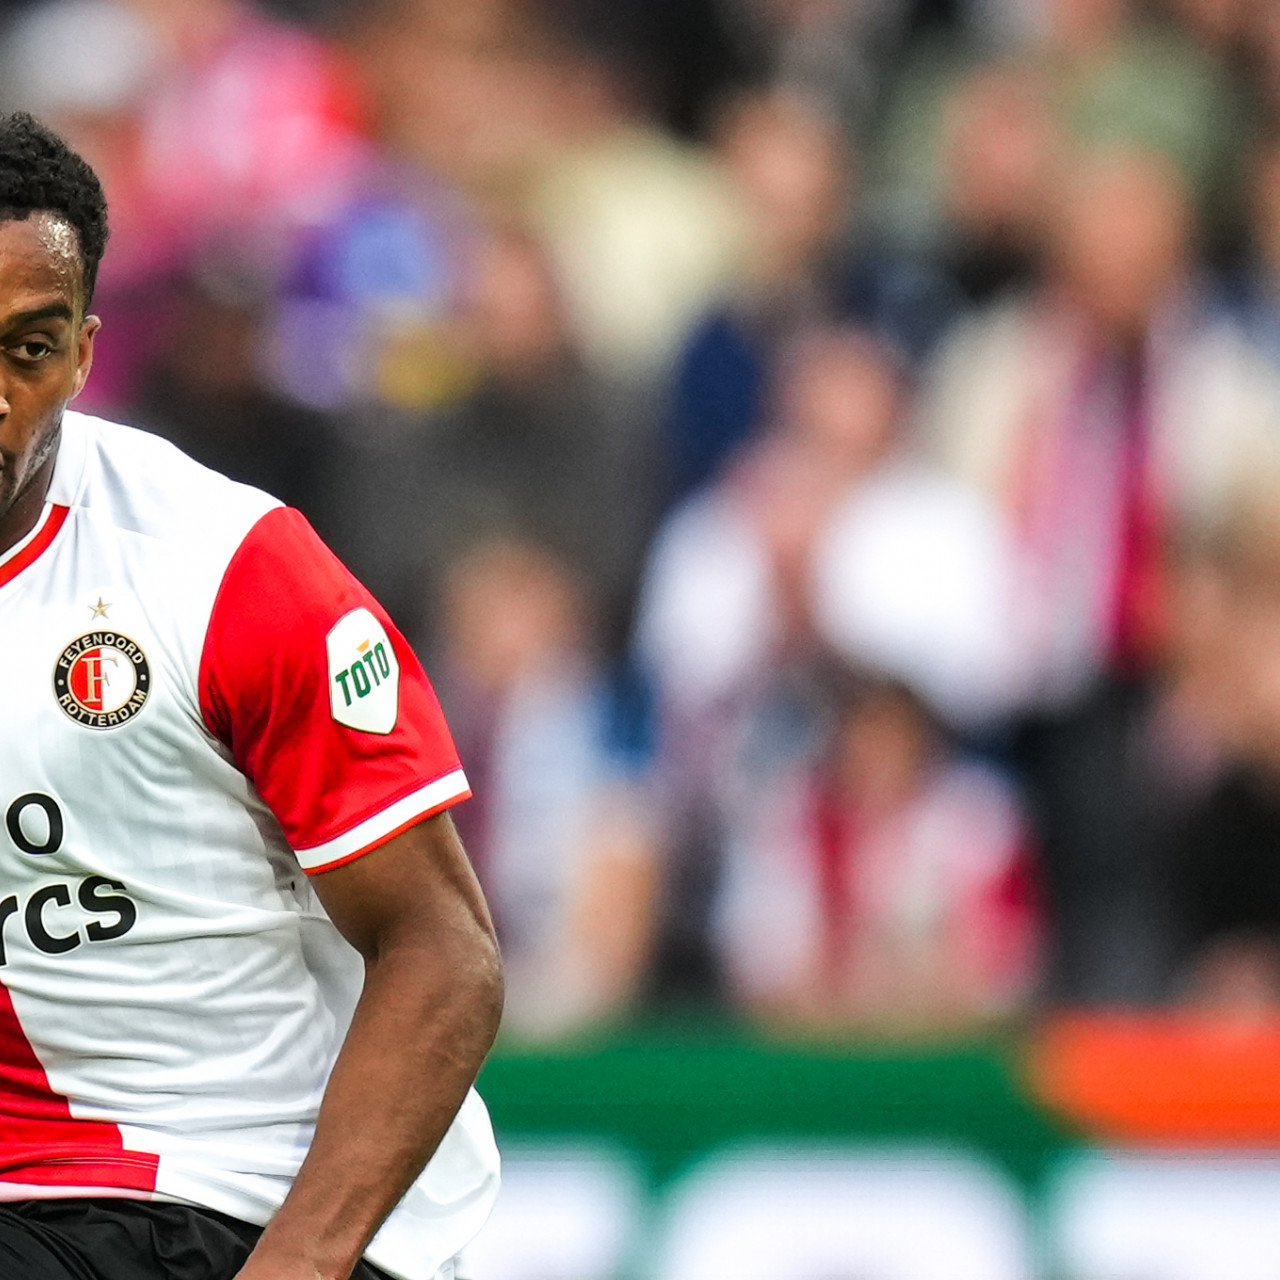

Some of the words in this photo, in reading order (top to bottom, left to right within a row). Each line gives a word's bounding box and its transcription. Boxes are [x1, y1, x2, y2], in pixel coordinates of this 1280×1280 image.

[58, 633, 145, 669] FEYENOORD
[334, 641, 390, 707] TOTO
[58, 688, 147, 727] ROTTERDAM
